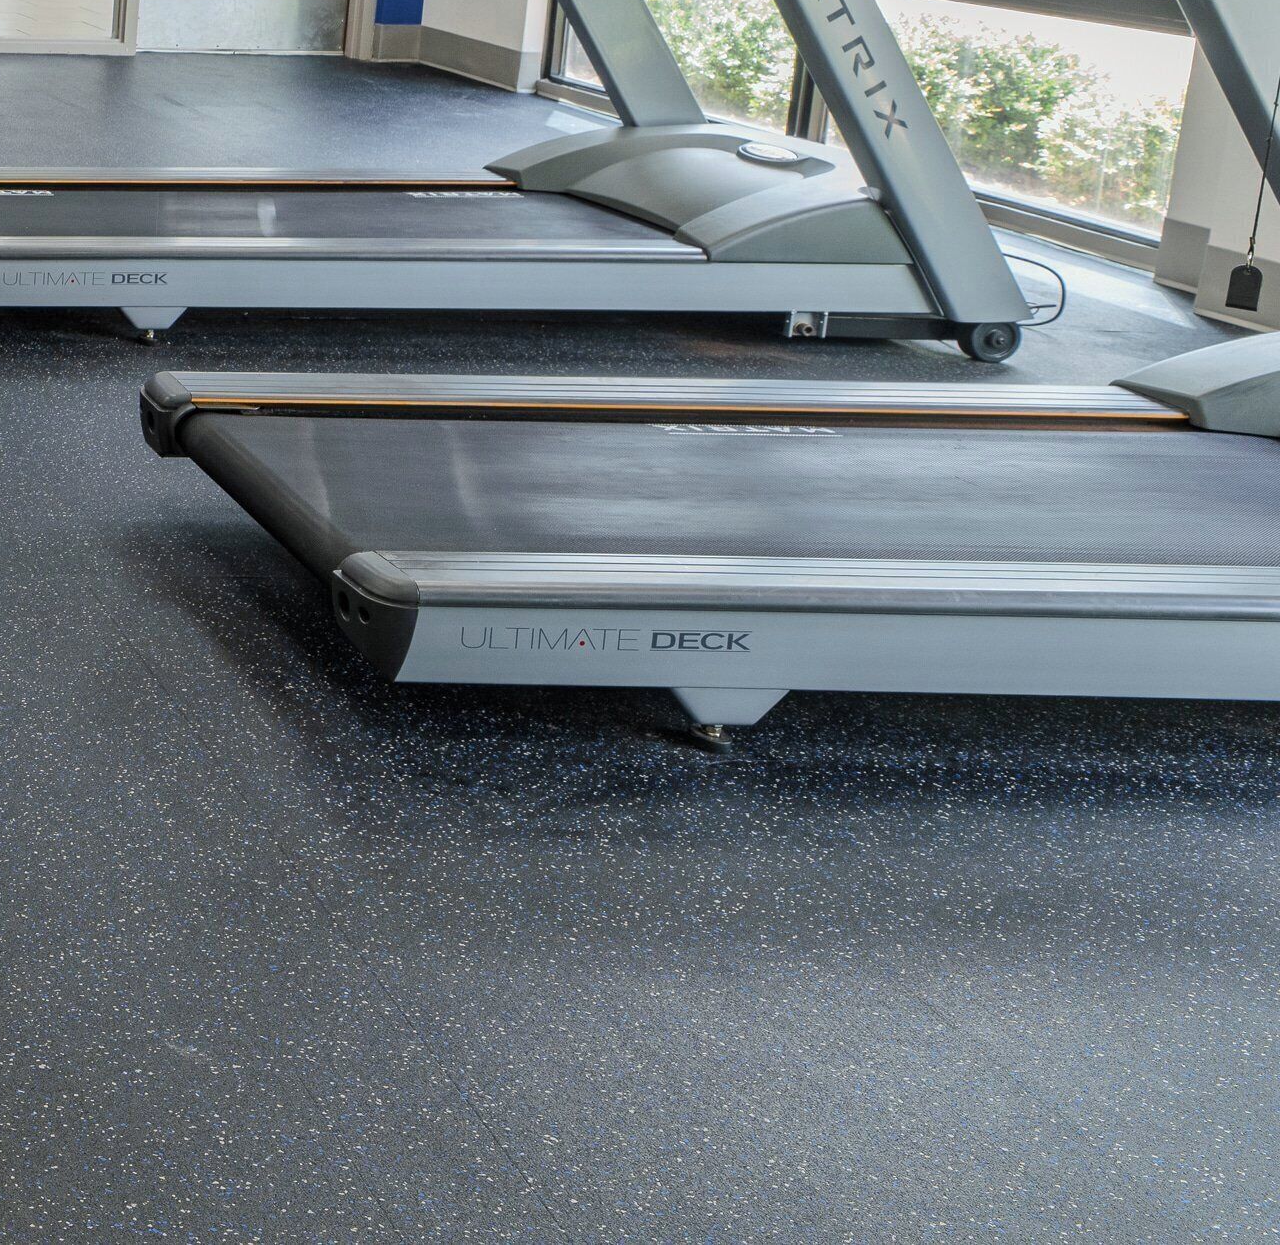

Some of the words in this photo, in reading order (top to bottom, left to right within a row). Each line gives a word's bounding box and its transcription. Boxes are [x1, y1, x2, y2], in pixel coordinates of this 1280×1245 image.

[2, 271, 106, 286] ULTIMATE
[111, 272, 168, 285] DECK
[460, 626, 641, 652] ULTIMATE
[650, 631, 751, 651] DECK
